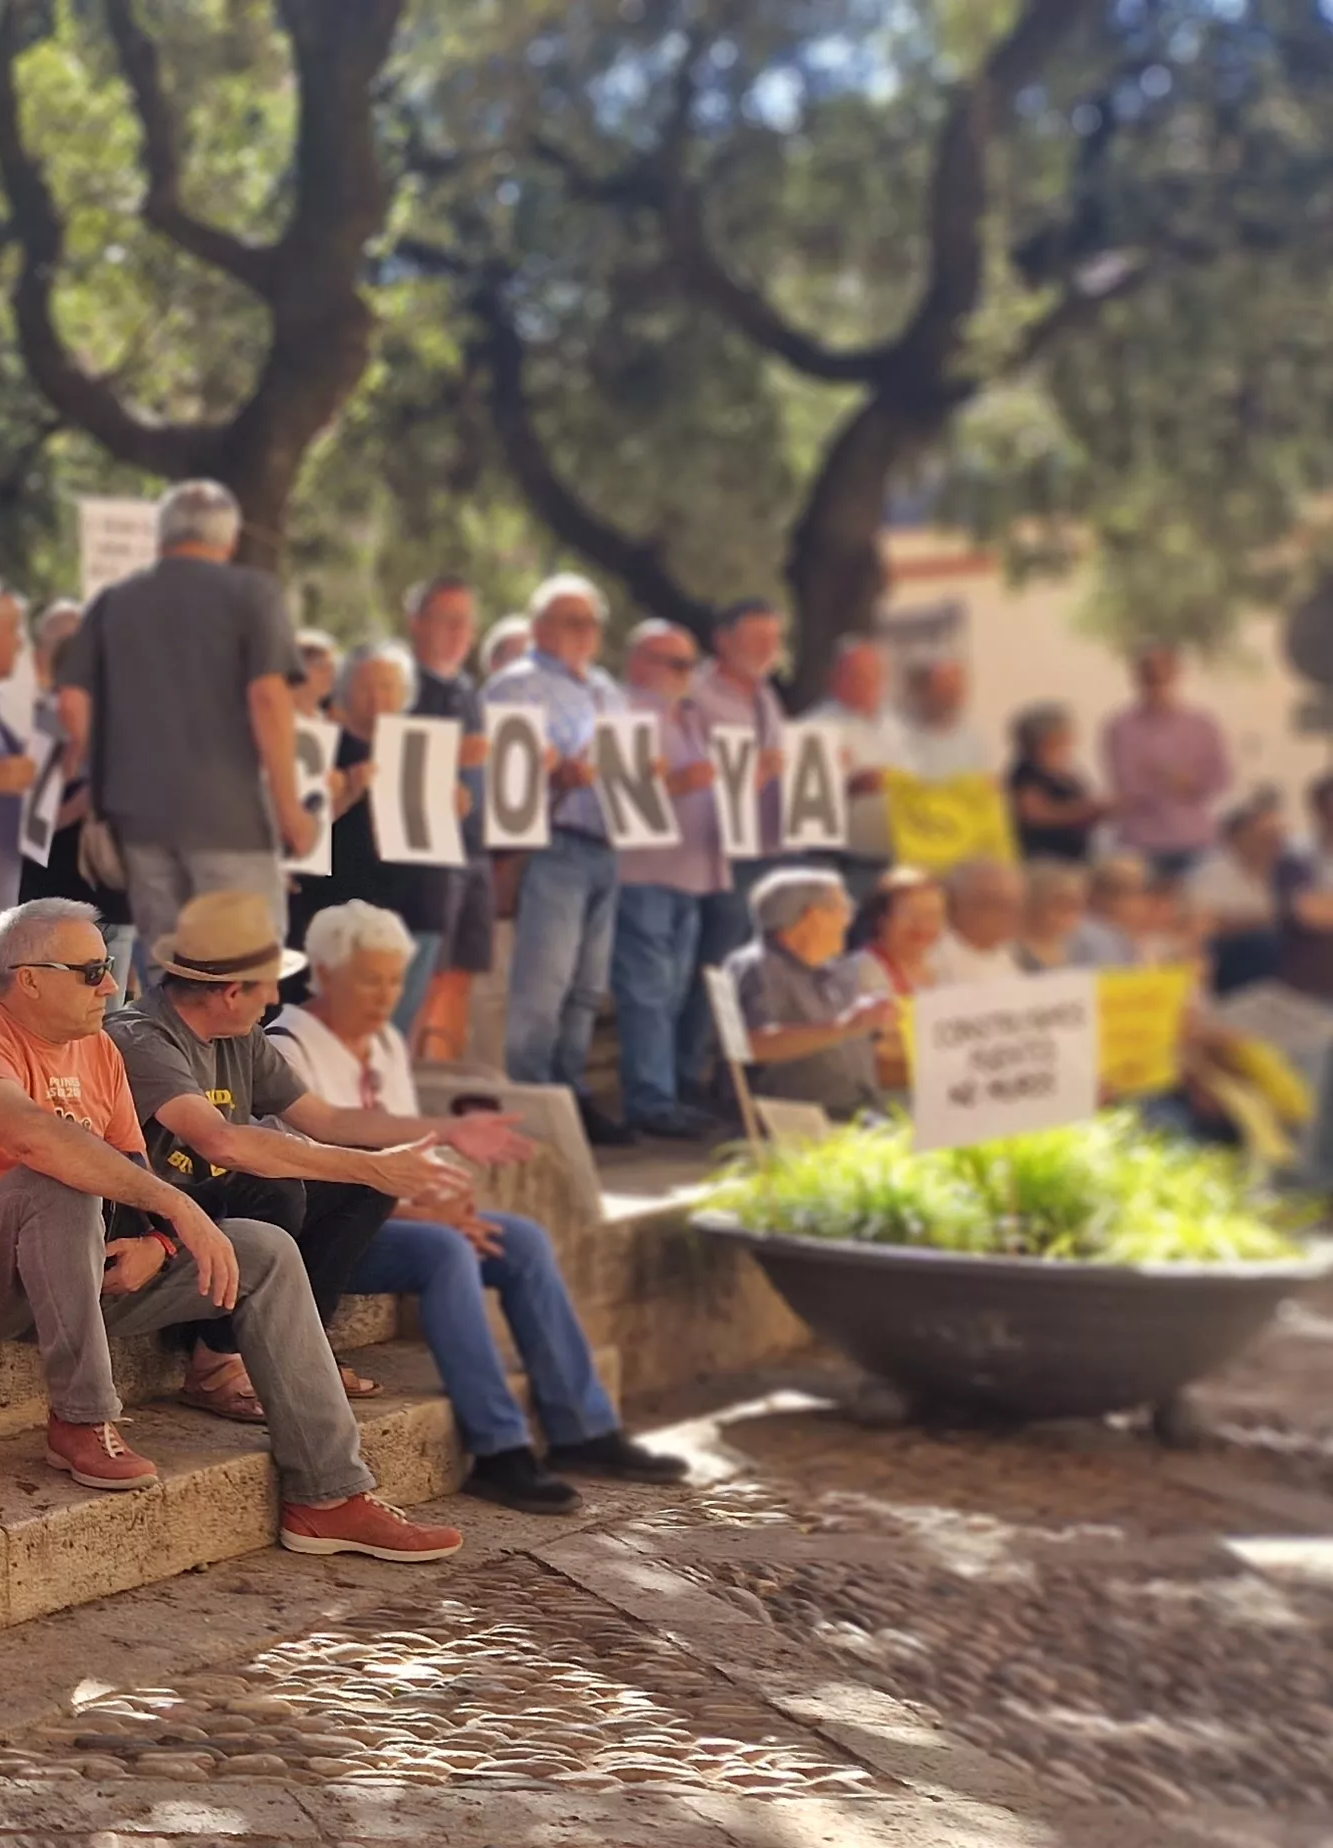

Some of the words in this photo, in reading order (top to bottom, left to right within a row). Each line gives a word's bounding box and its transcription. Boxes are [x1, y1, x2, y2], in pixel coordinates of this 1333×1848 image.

[400, 729, 432, 852] I
[491, 712, 543, 836] O
[594, 721, 673, 837] N
[715, 734, 754, 845] Y
[788, 732, 840, 840] A
